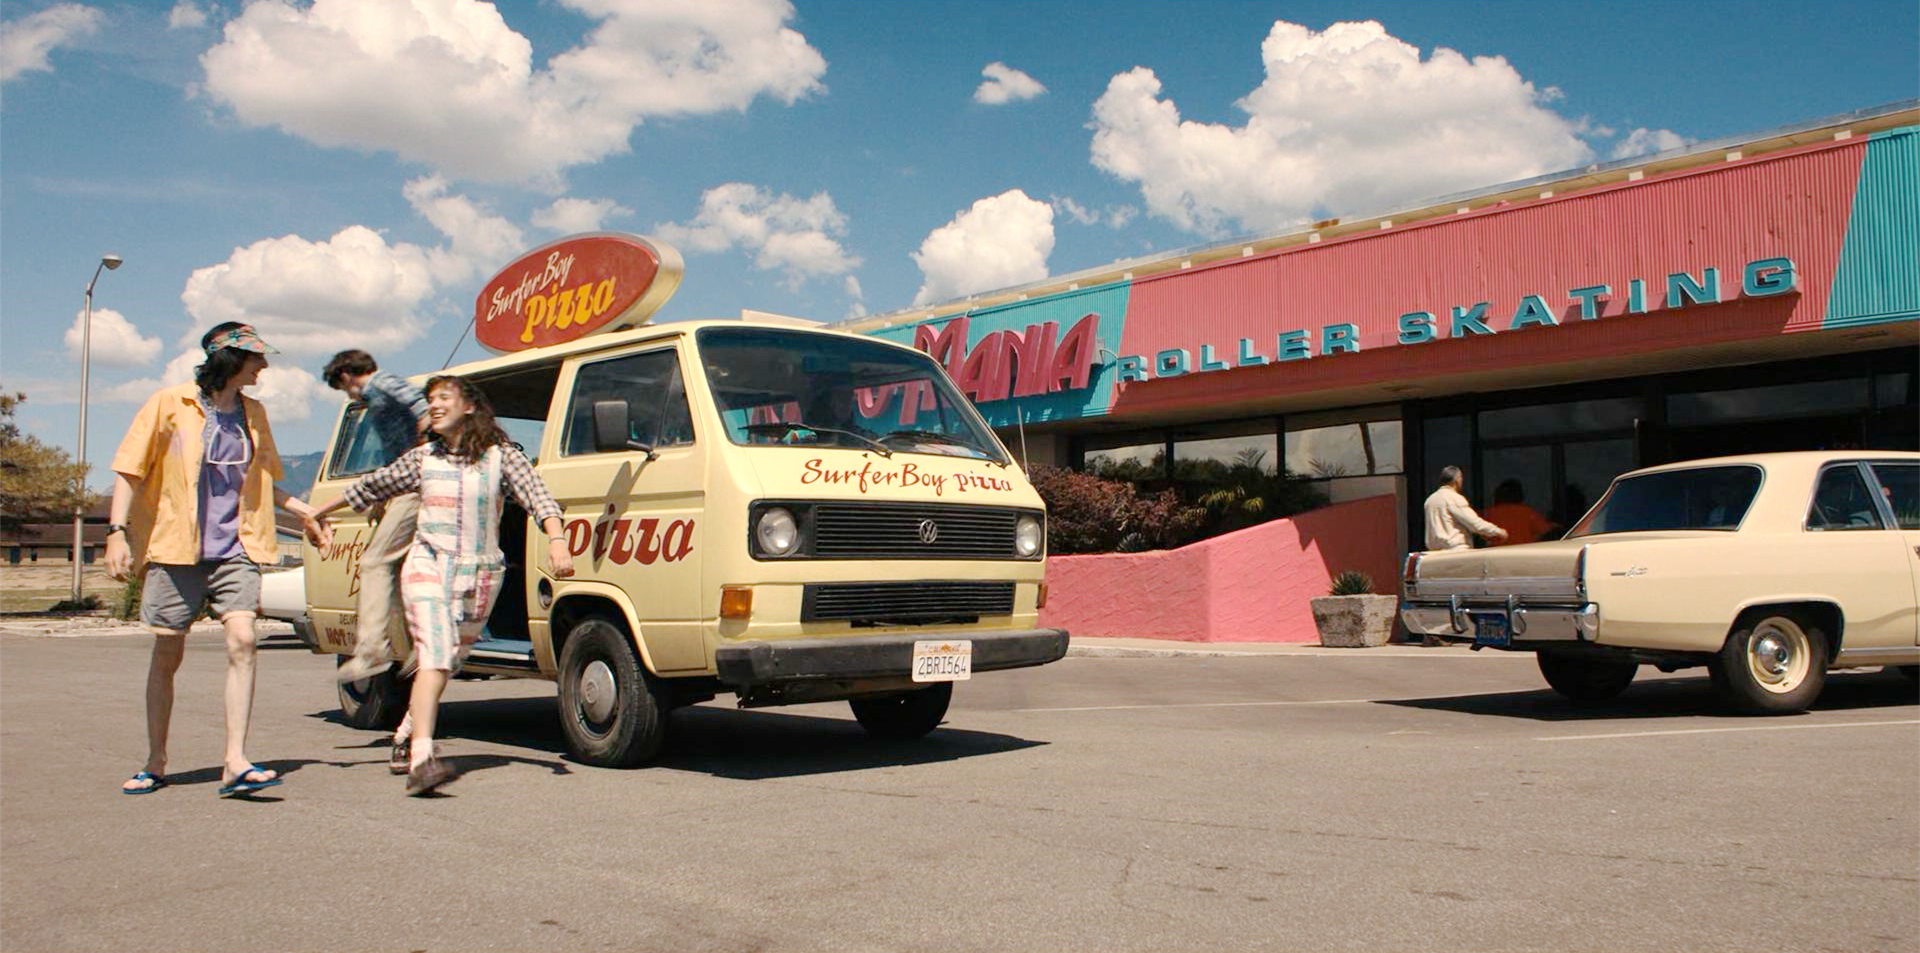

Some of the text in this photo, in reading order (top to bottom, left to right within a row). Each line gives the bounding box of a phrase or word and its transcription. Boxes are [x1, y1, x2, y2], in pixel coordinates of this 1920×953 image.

[487, 250, 576, 322] Surfer Boy
[520, 276, 616, 343] pizza
[1116, 256, 1798, 383] ROLLER SKATING
[800, 459, 1014, 497] Surfer Boy pizza
[918, 655, 966, 676] 2BRI564
